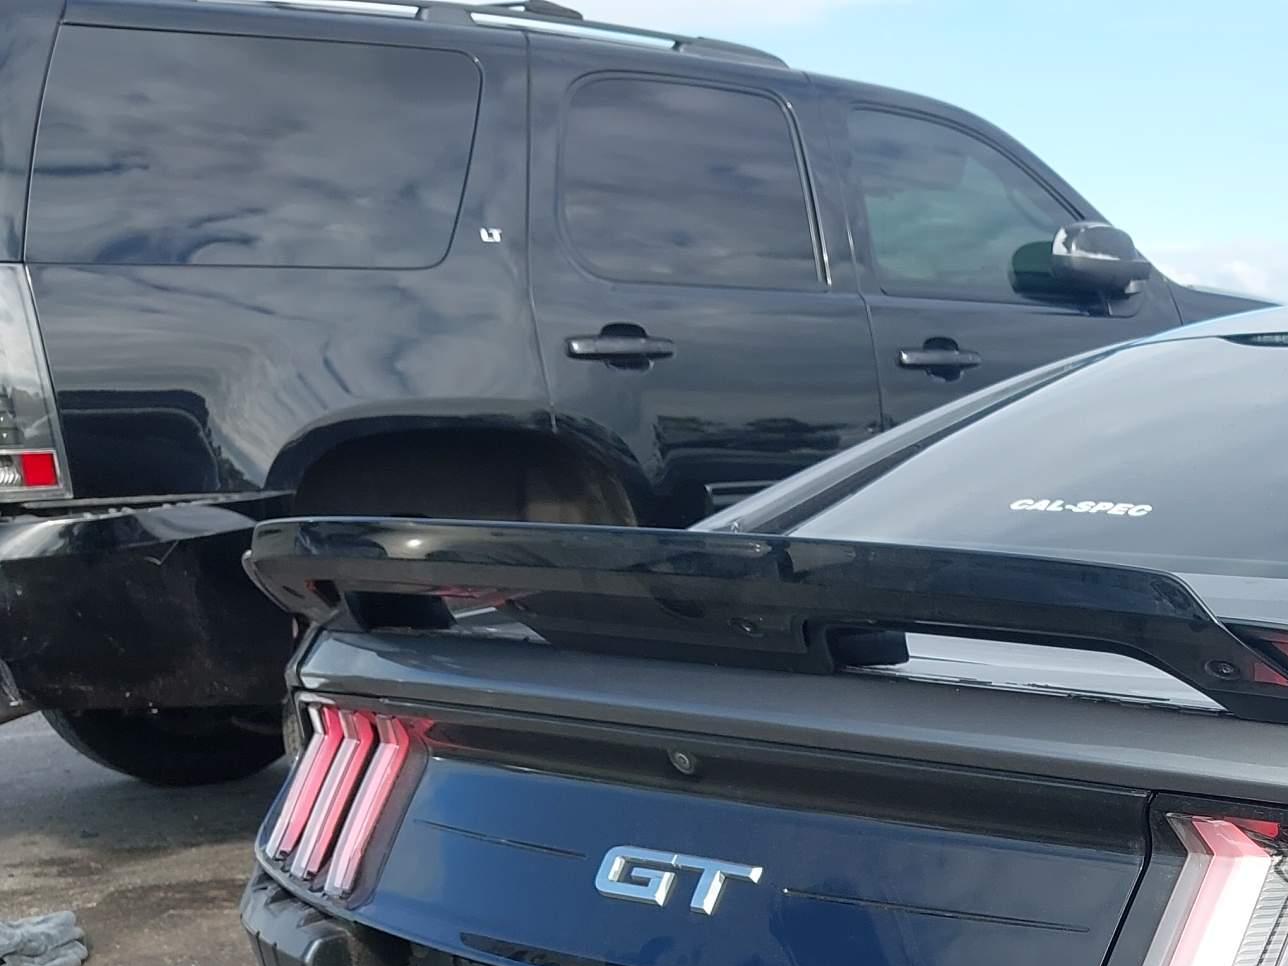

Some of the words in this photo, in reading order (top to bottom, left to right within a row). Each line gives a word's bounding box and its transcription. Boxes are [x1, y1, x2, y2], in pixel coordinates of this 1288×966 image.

[480, 228, 502, 243] LT
[1010, 499, 1152, 517] CAL-SPEC
[595, 845, 764, 916] GT
